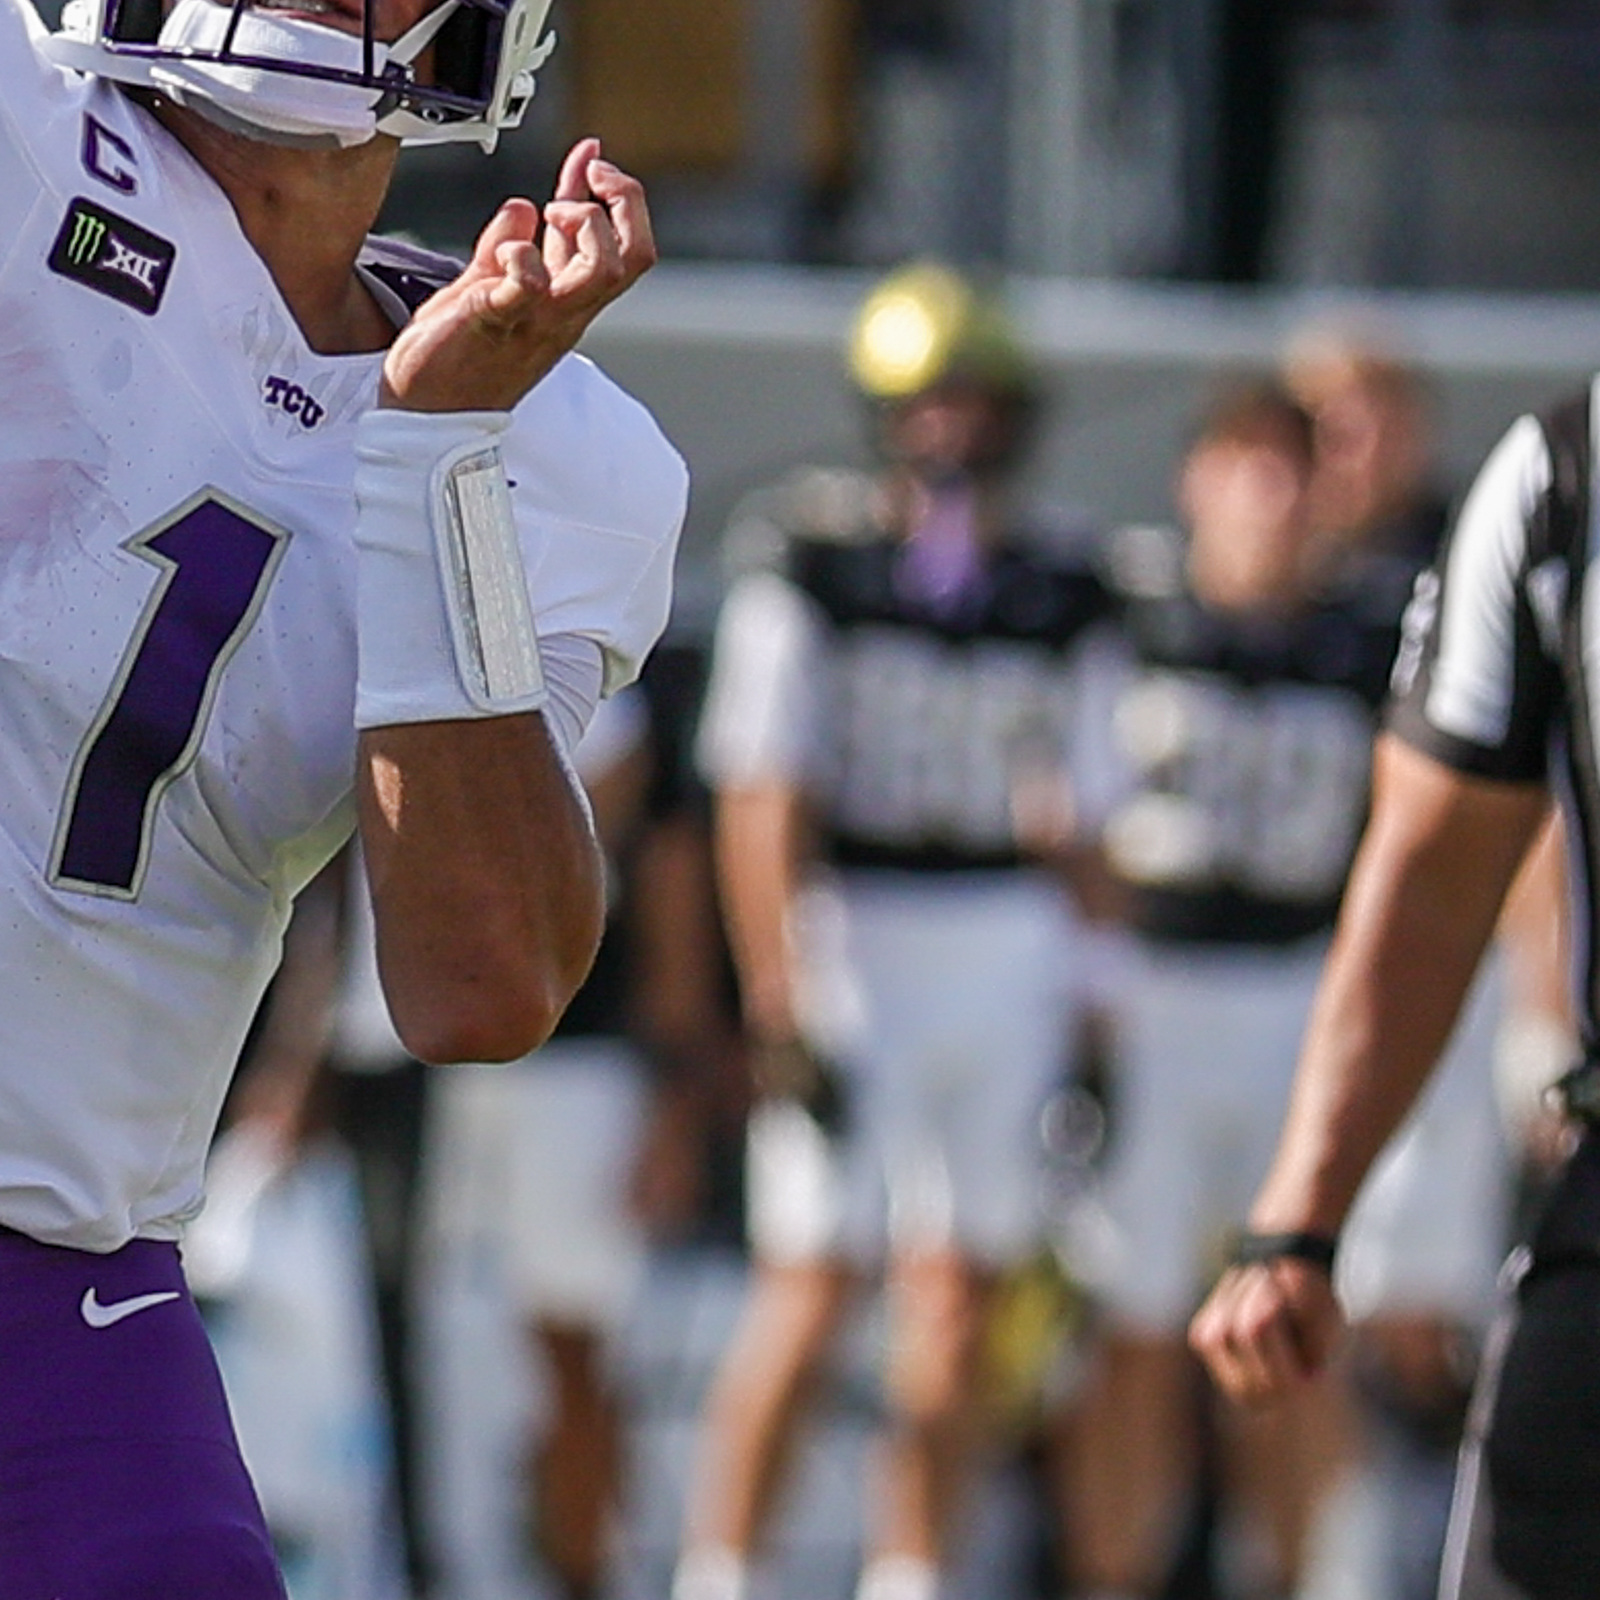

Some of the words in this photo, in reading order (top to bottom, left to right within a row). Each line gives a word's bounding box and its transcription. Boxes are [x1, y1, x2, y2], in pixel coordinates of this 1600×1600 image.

[82, 110, 138, 196] C
[263, 374, 326, 430] TCU
[46, 484, 293, 902] 1
